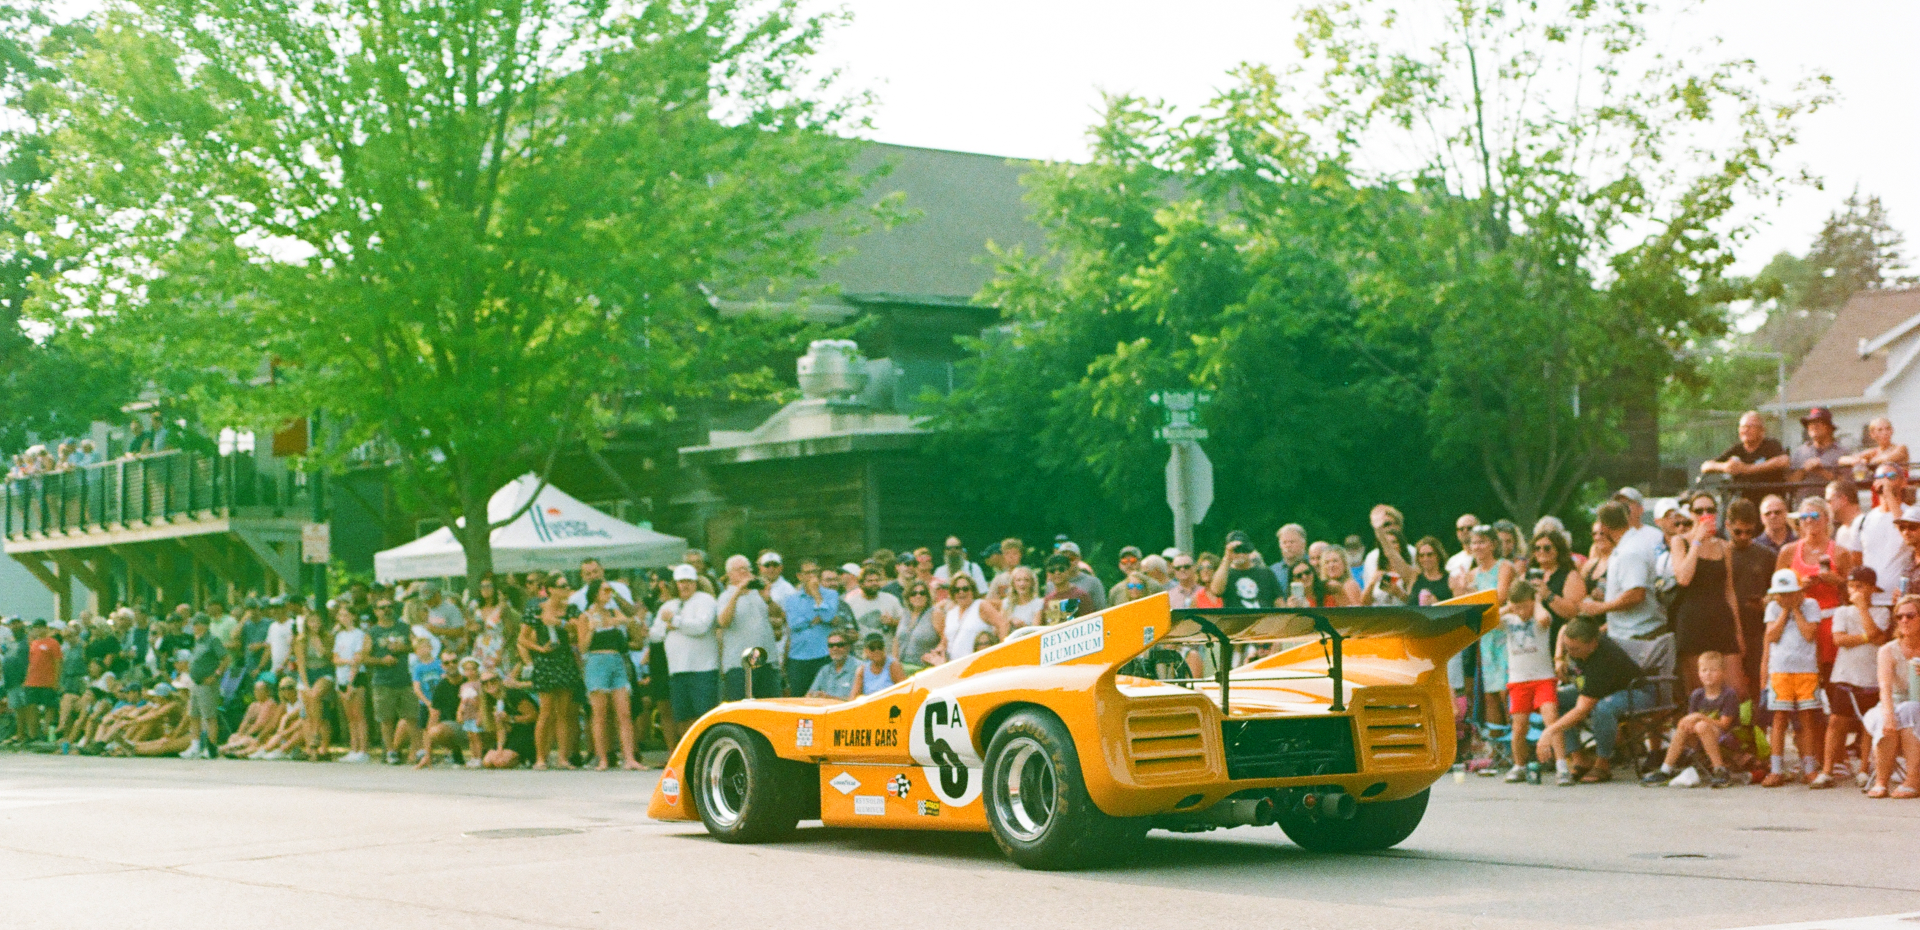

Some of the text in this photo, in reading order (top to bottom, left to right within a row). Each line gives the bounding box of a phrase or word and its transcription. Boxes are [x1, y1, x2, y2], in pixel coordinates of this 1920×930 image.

[1043, 620, 1102, 648] REYNOLDS
[1042, 637, 1101, 664] ALUMINUM
[951, 703, 962, 728] A
[875, 728, 898, 747] CARS
[924, 700, 968, 799] 6
[663, 780, 679, 793] Gulf
